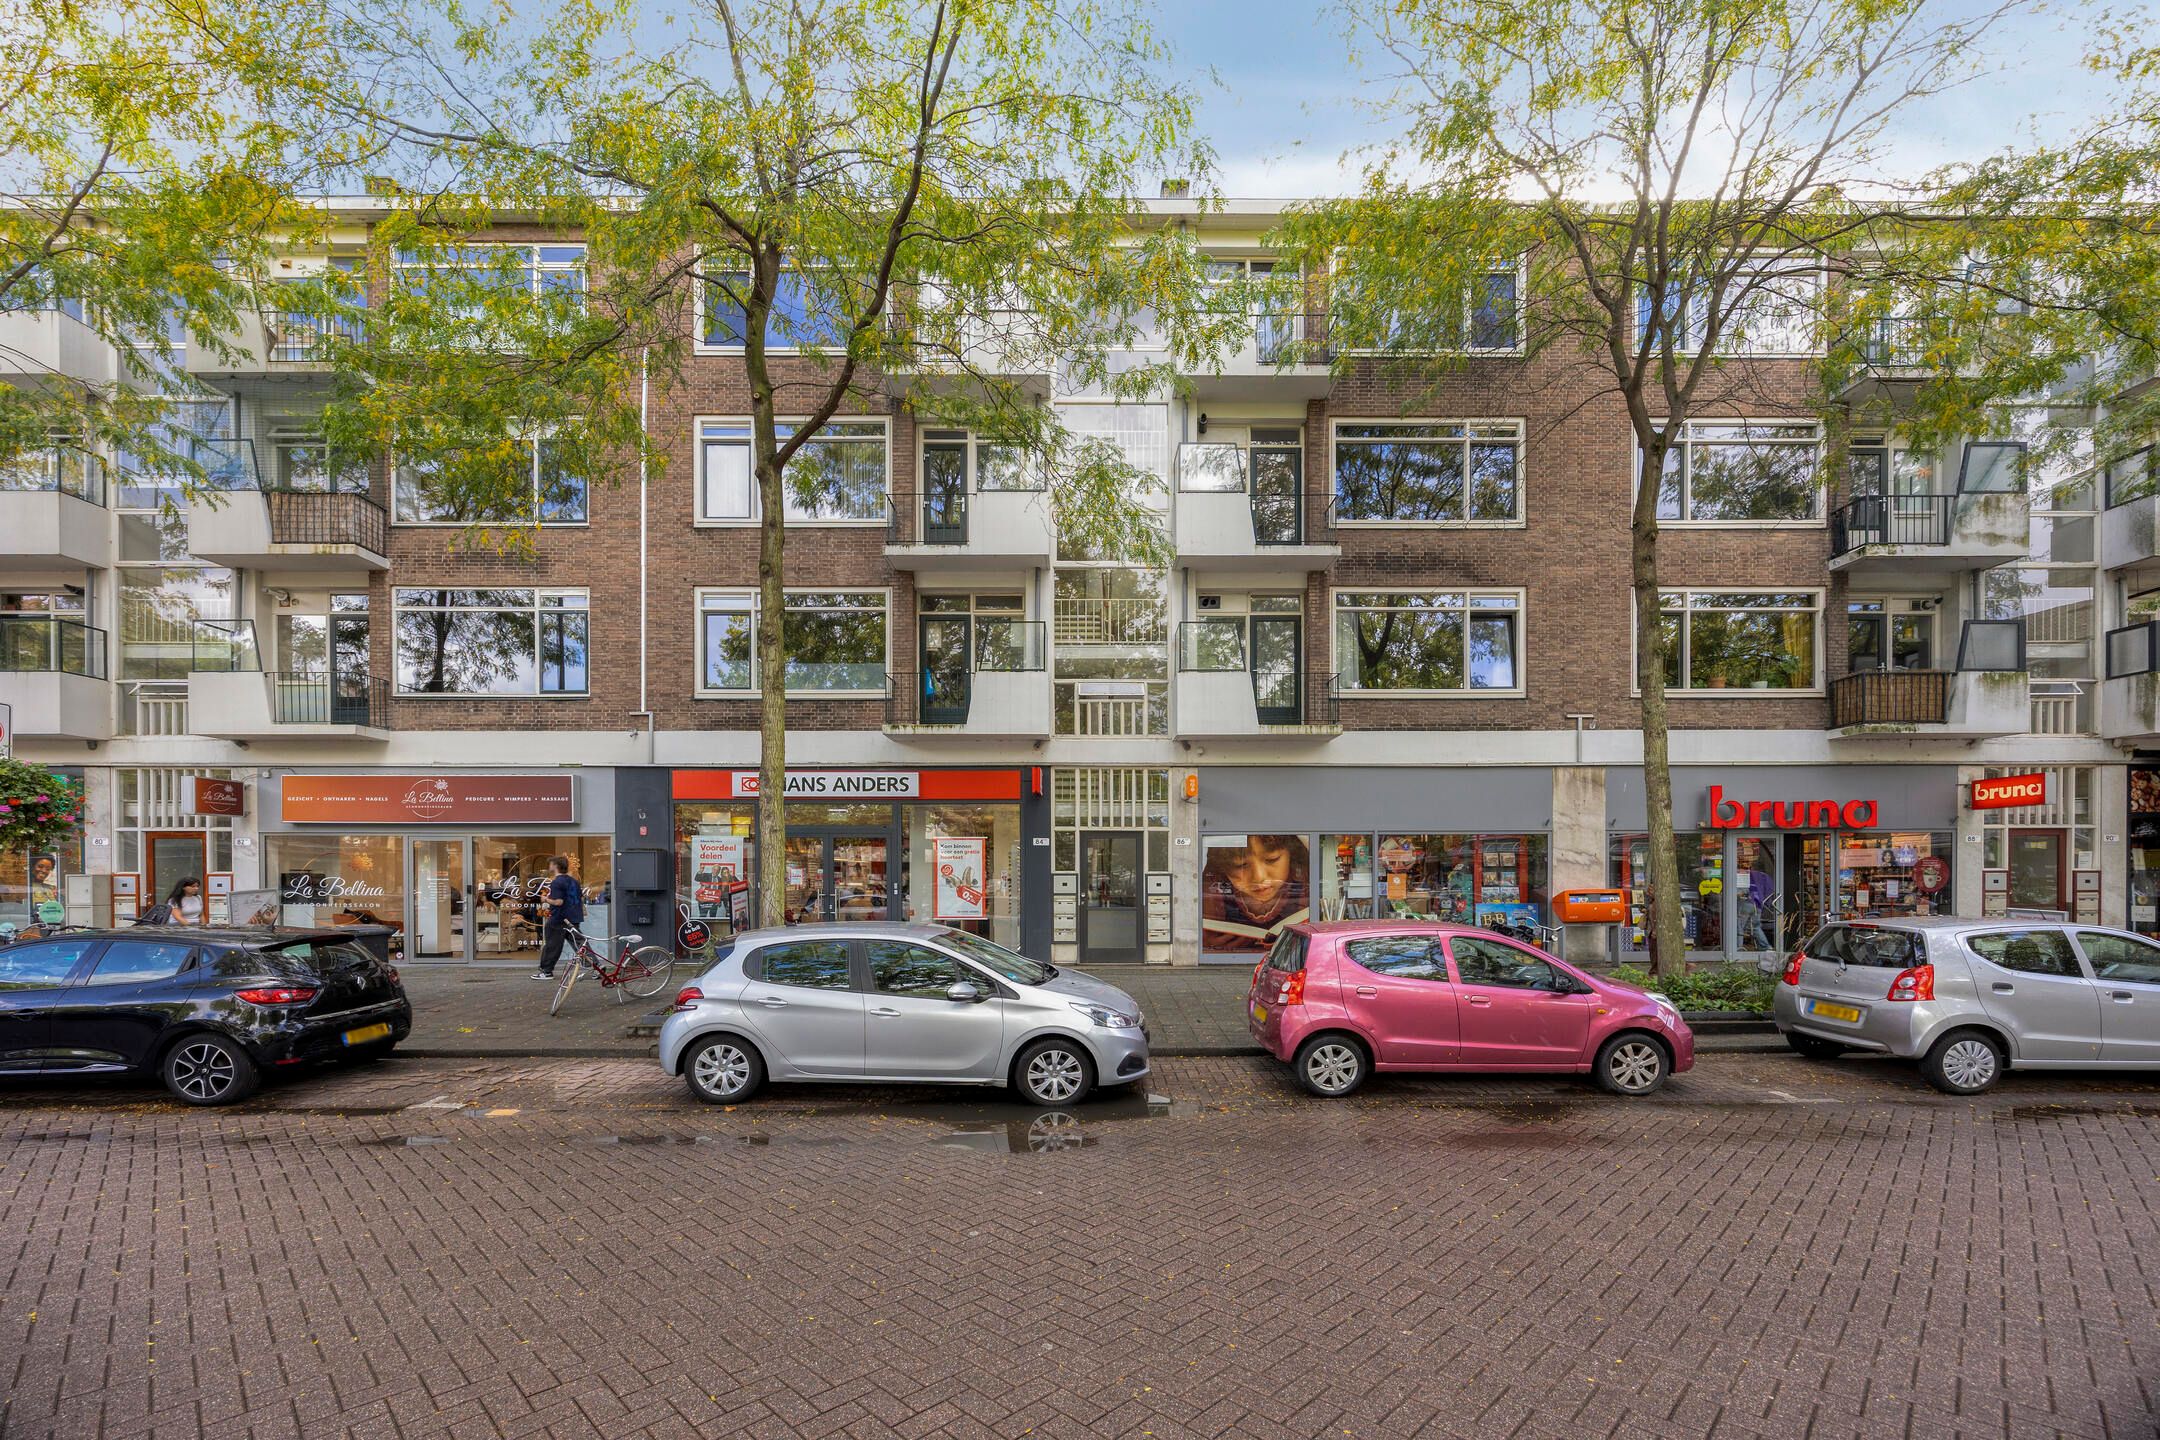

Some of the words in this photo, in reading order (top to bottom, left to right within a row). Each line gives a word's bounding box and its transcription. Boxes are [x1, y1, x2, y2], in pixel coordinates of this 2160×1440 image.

[832, 777, 909, 792] ANDERS
[1975, 783, 2042, 801] bruna
[400, 790, 416, 804] La
[418, 791, 454, 803] Bellina
[1709, 785, 1878, 829] bruna
[700, 844, 737, 852] Voordeel
[700, 852, 723, 860] delen
[284, 874, 314, 899] La
[317, 876, 385, 897] Bellina
[491, 875, 522, 899] La
